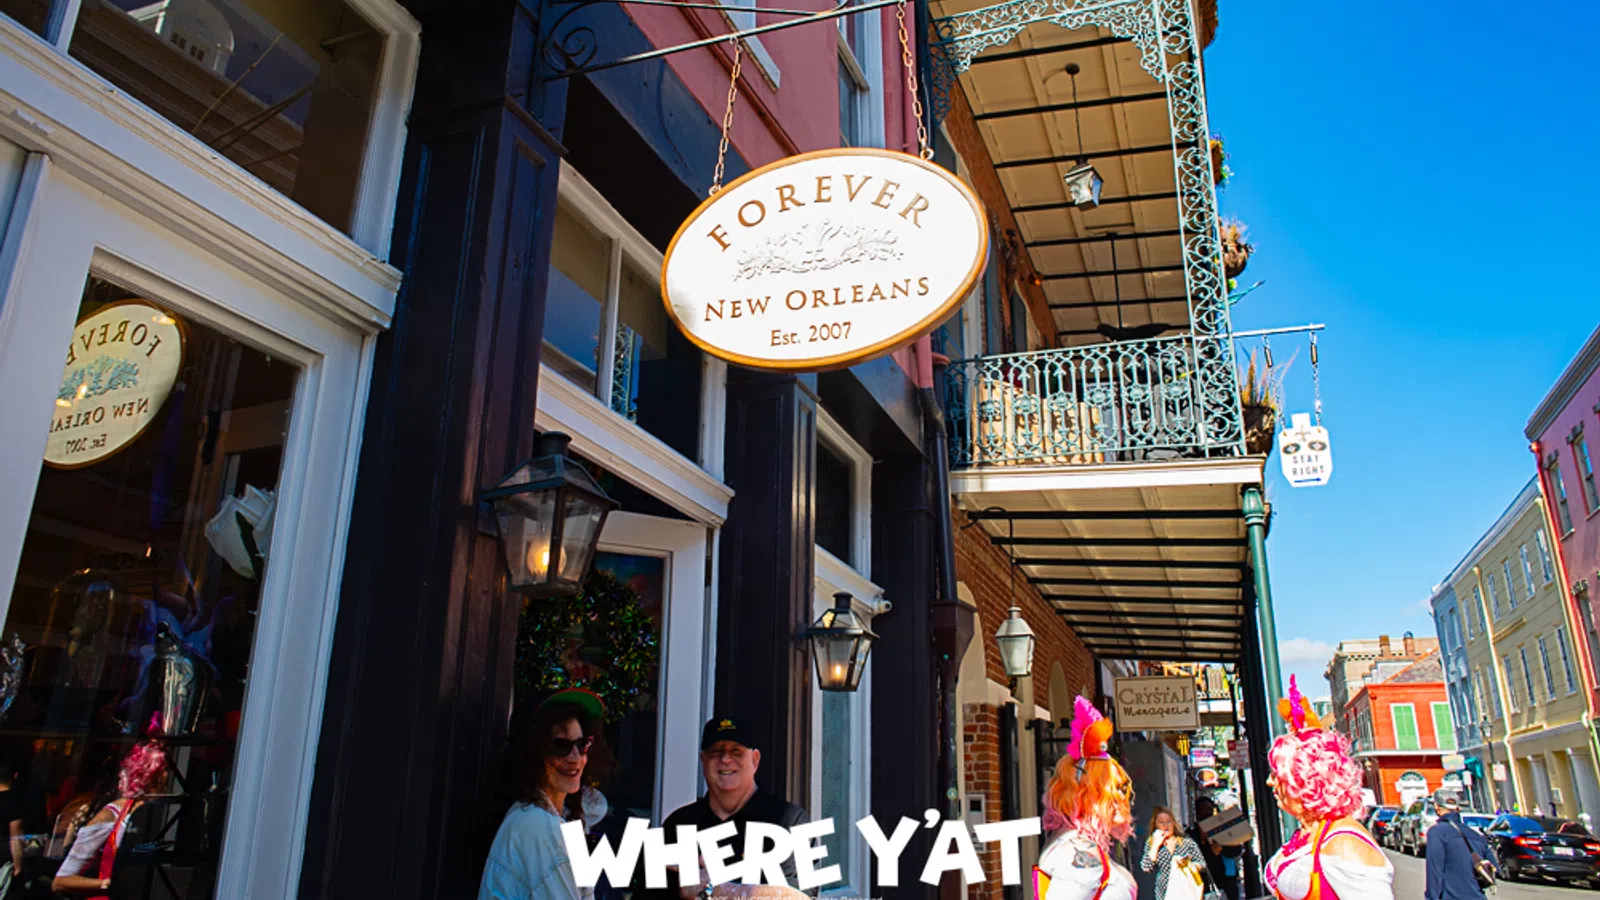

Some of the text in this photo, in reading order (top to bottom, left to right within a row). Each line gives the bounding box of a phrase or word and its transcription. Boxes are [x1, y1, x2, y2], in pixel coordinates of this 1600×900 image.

[706, 174, 930, 252] FOREVER
[703, 276, 931, 322] NEW ORLEANS
[769, 321, 853, 347] Est. 2007
[1292, 455, 1319, 464] STAY
[1292, 465, 1325, 476] RIGHT
